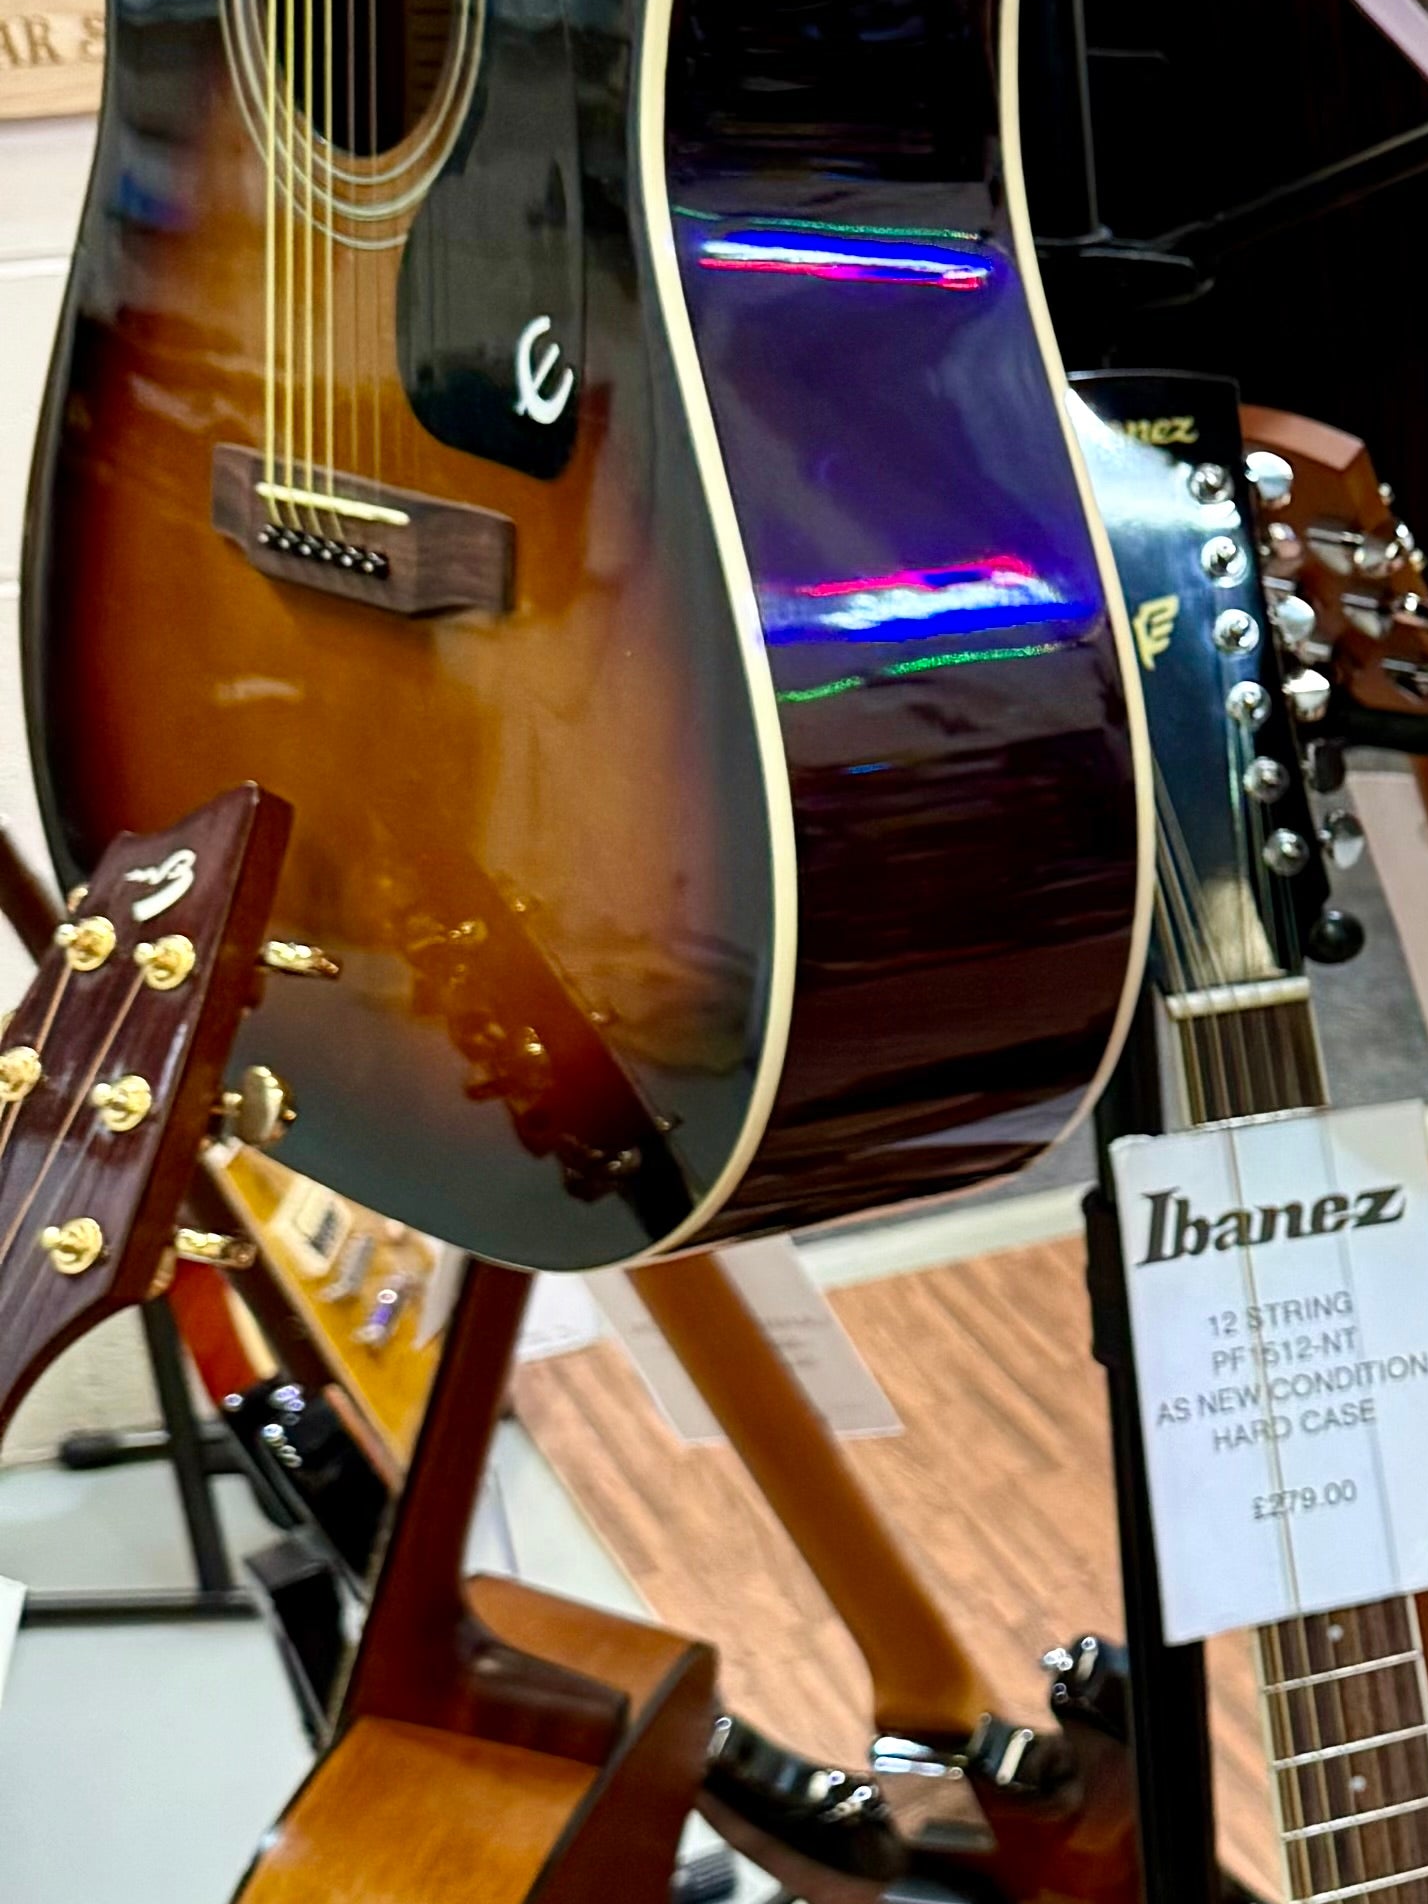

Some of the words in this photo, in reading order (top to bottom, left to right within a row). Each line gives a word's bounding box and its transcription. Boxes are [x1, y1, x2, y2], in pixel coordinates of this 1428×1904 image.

[1136, 1184, 1406, 1266] Ibanez
[1207, 1310, 1239, 1337] 12
[1245, 1290, 1354, 1332] STRING
[1156, 1396, 1192, 1426] AS
[1197, 1384, 1262, 1418] NEW
[1212, 1414, 1293, 1452] HARD
[1300, 1397, 1377, 1434] CASE
[1254, 1477, 1358, 1521] £279.00
